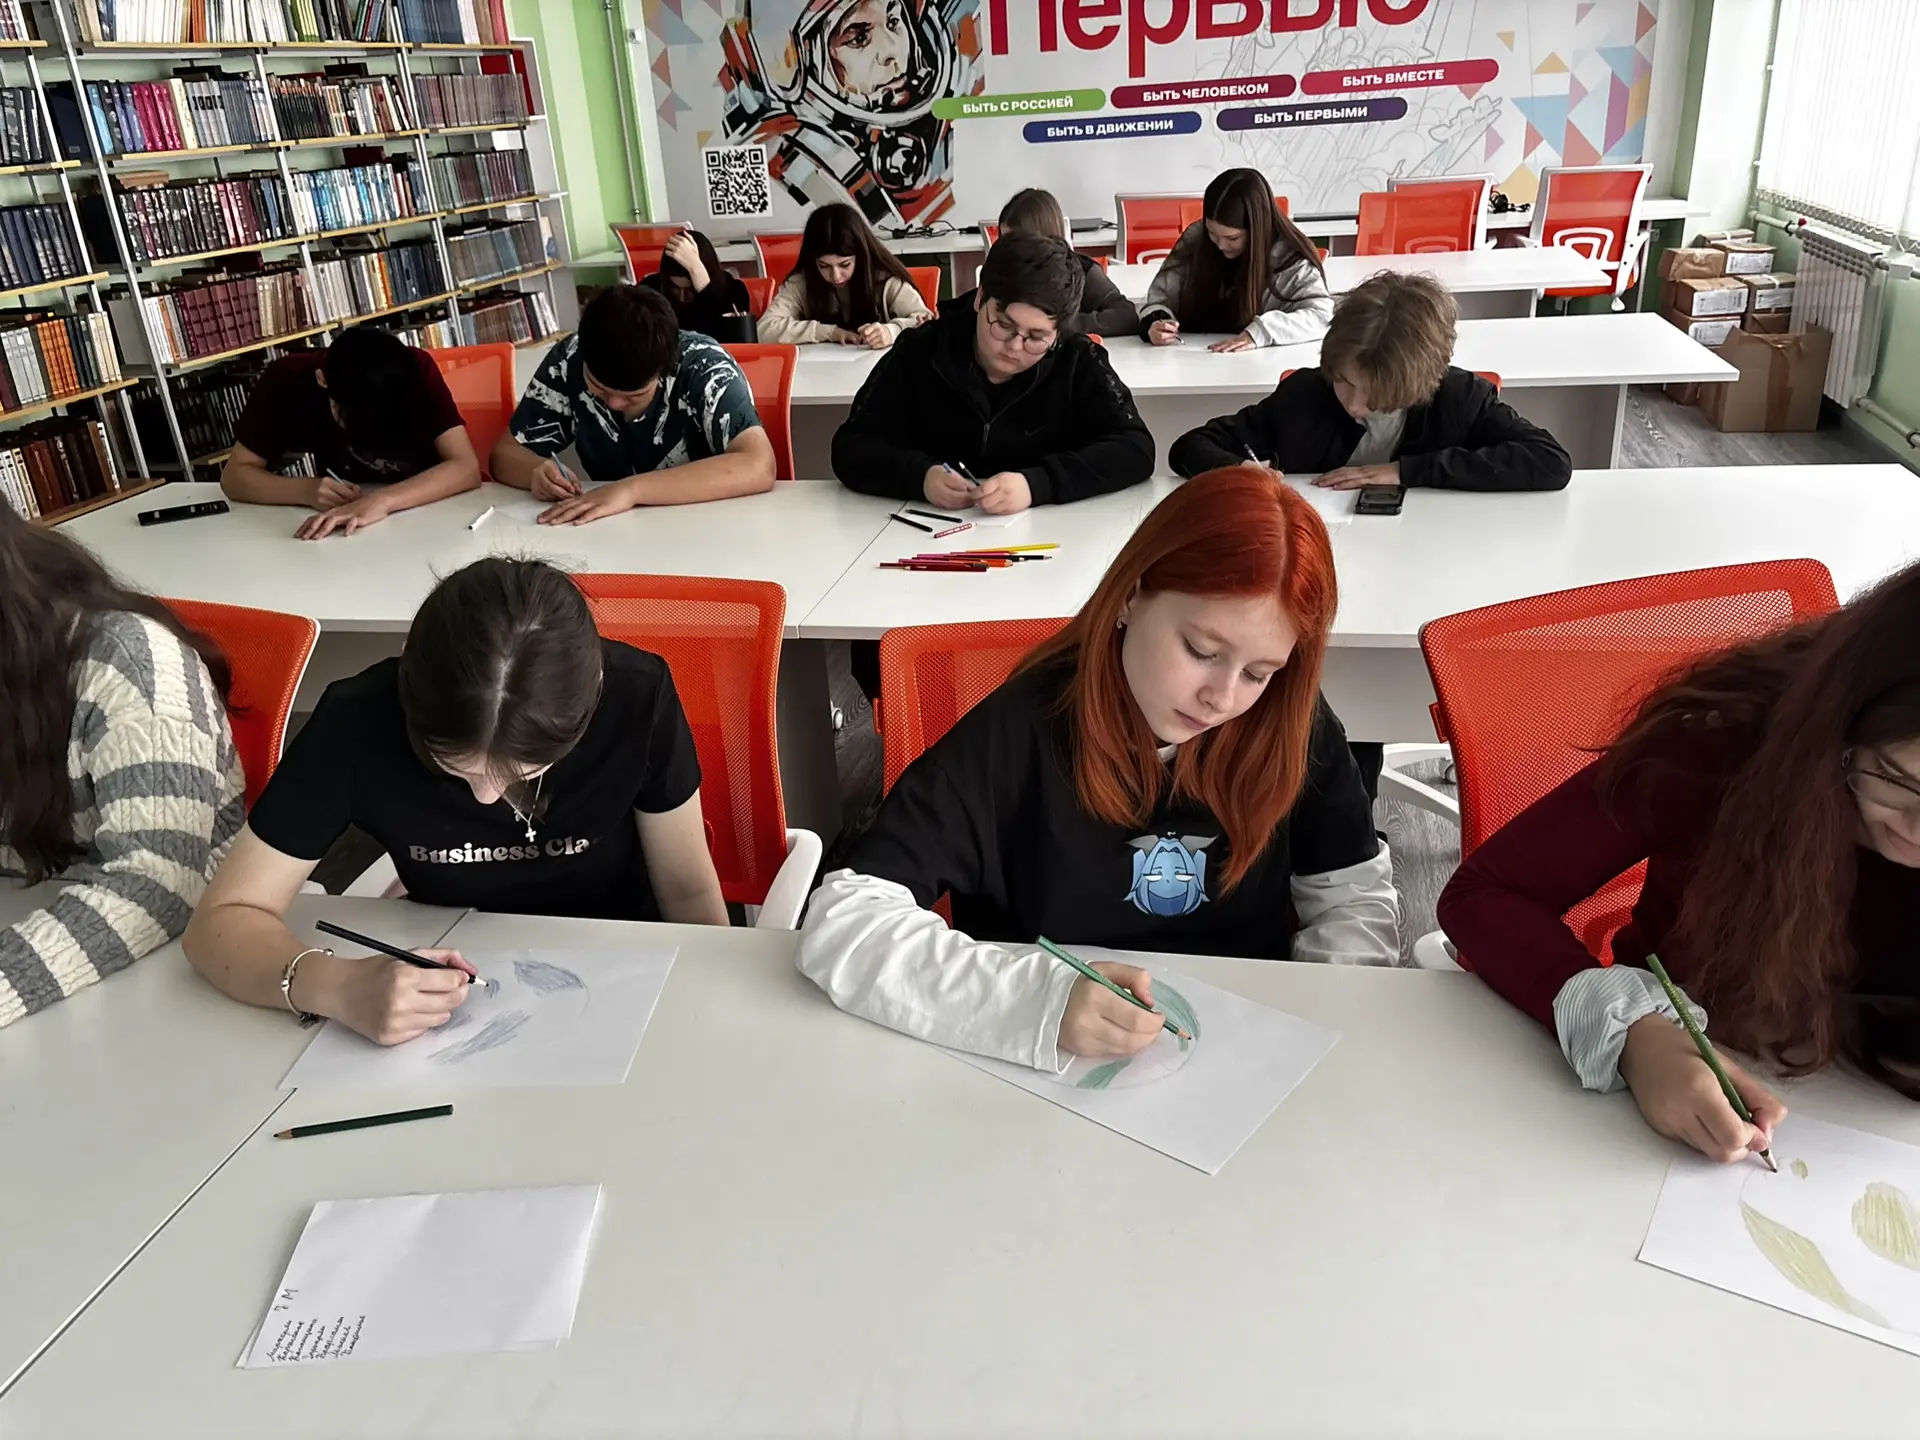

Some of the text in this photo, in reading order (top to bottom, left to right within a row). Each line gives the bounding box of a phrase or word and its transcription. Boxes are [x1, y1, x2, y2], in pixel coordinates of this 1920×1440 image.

[1342, 69, 1444, 87] БЫТЬ ВМЕСТЕ
[1143, 83, 1269, 102] БЫТЬ ЧЕЛОВЕКОМ
[963, 95, 1074, 114] БЫТЬ С РОССИЕЙ
[1254, 105, 1368, 124] БЫТЬ ПЕРВЫМИ
[1047, 119, 1174, 137] БЫТЬ В ДВИЖЕНИИ
[408, 836, 591, 864] Business Cla
